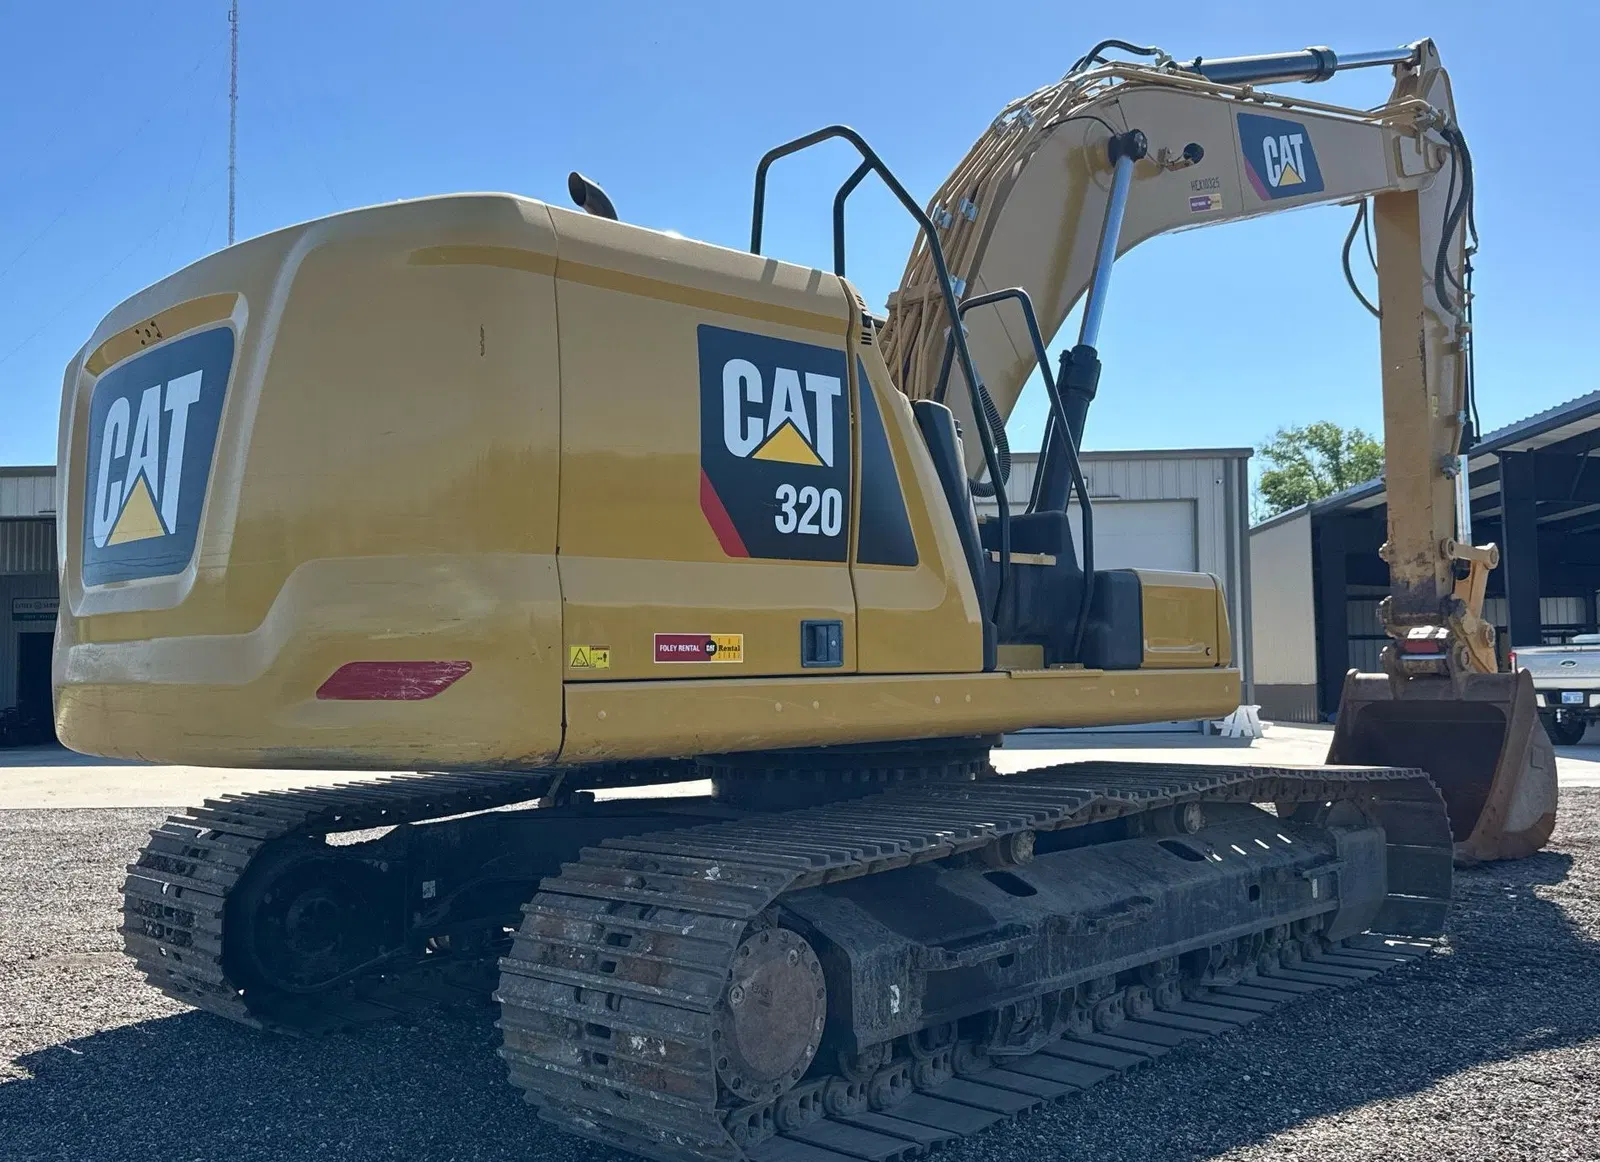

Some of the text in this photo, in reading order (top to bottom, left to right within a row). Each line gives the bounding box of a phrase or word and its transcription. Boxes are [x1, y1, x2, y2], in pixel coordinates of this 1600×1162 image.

[1263, 133, 1306, 187] CAT
[722, 358, 842, 467] CAT
[92, 369, 203, 548] CAT
[774, 483, 843, 537] 320
[659, 644, 700, 652] FOLEY RENTAL
[718, 644, 741, 652] Rental
